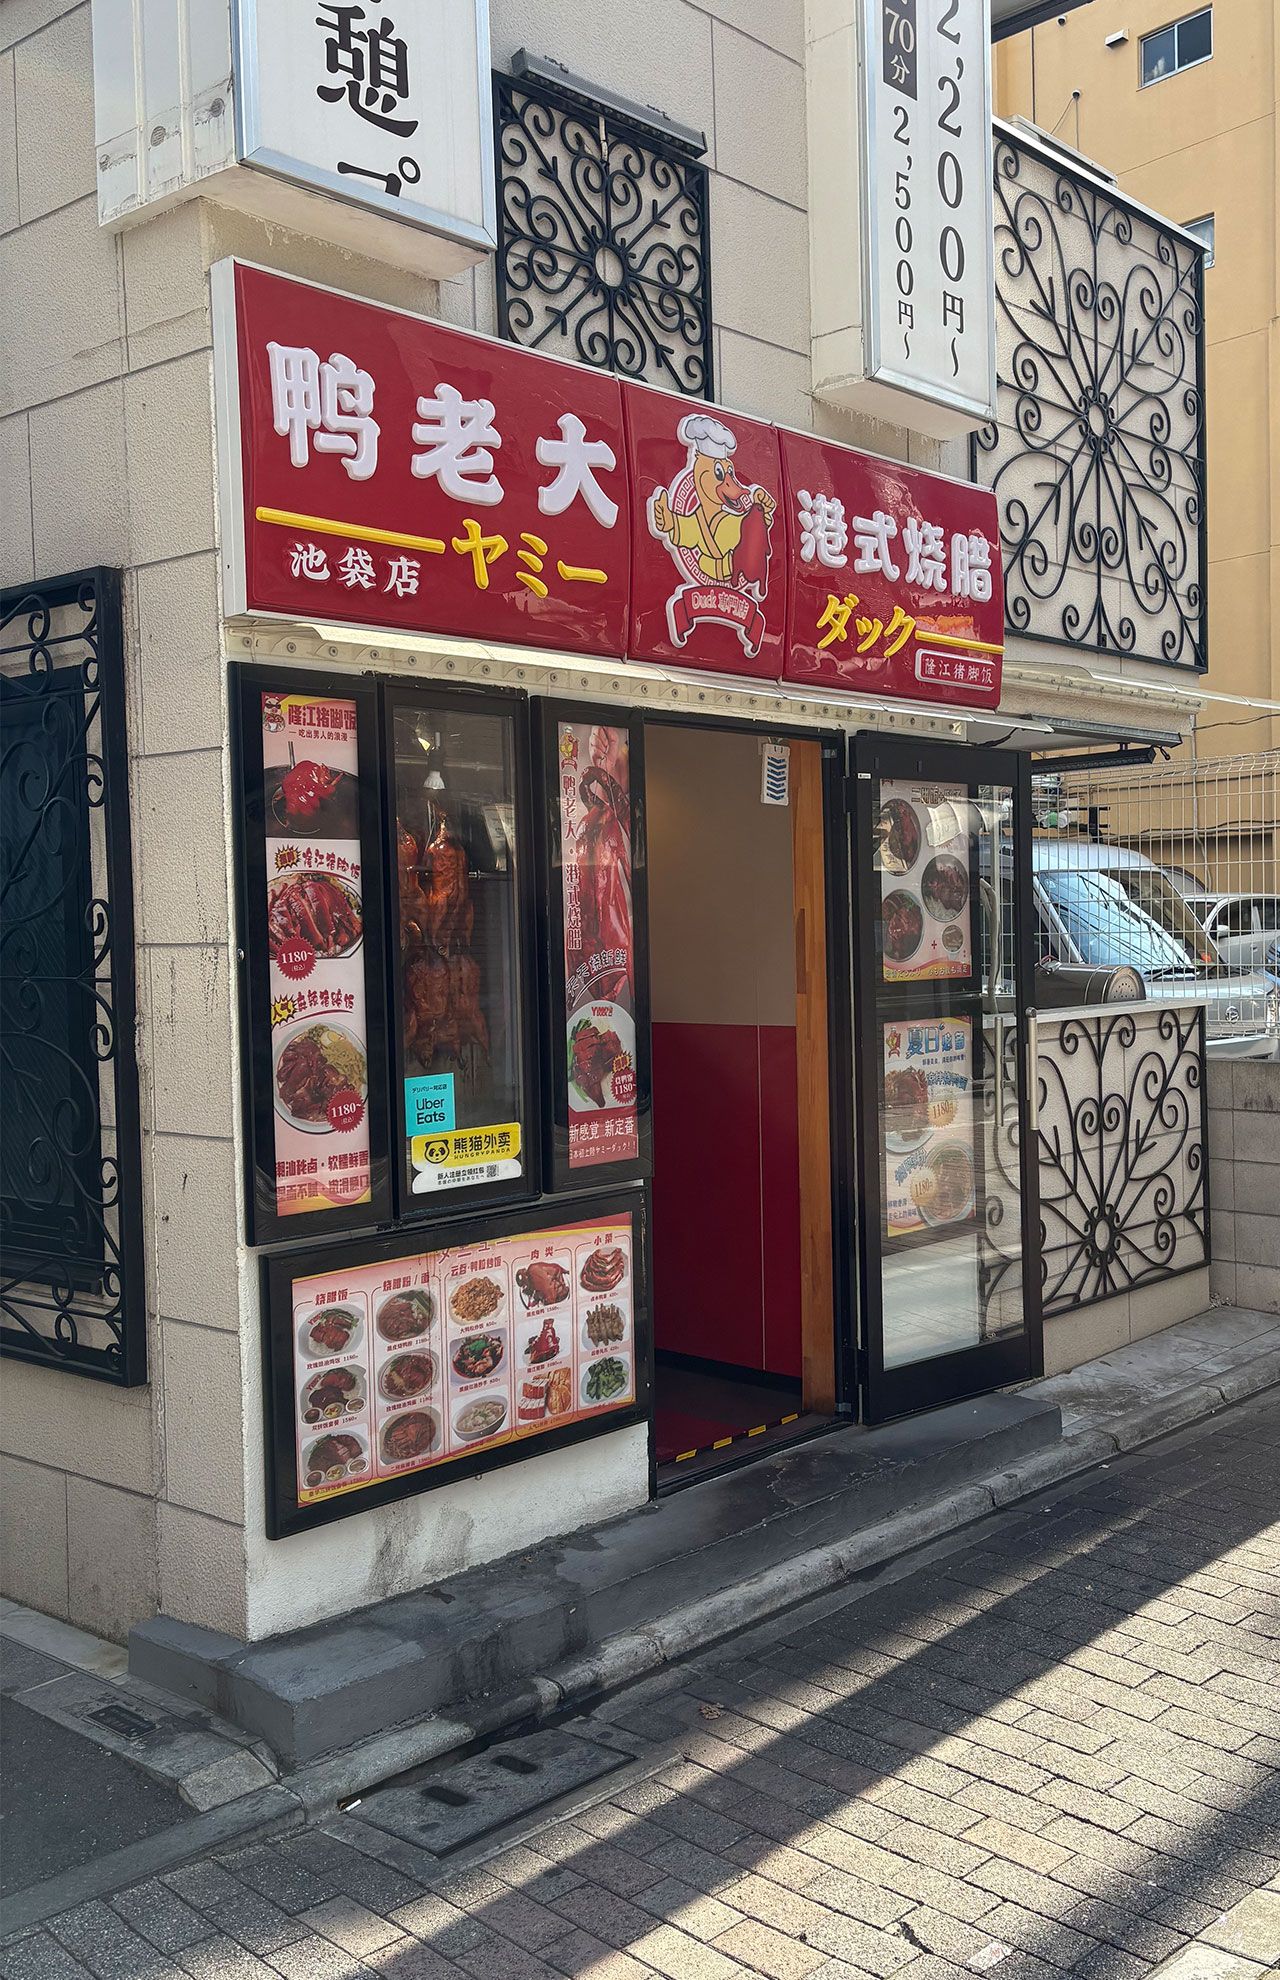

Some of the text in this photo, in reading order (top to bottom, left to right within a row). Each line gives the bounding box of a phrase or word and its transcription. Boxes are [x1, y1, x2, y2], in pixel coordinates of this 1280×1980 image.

[266, 341, 620, 529] 鸭老大
[451, 518, 609, 599] ヤミー
[797, 489, 993, 603] 港式烧腊
[290, 542, 421, 597] 池袋店
[691, 589, 717, 610] Duck
[816, 592, 917, 658] ダック
[924, 657, 993, 684] 隆江猪脚饭
[416, 1098, 445, 1111] Uber
[416, 1111, 446, 1125] Eats
[603, 1116, 635, 1138] 新定番
[453, 1131, 511, 1155] 熊猫外卖
[453, 1147, 511, 1160] HUNGRYPANDA
